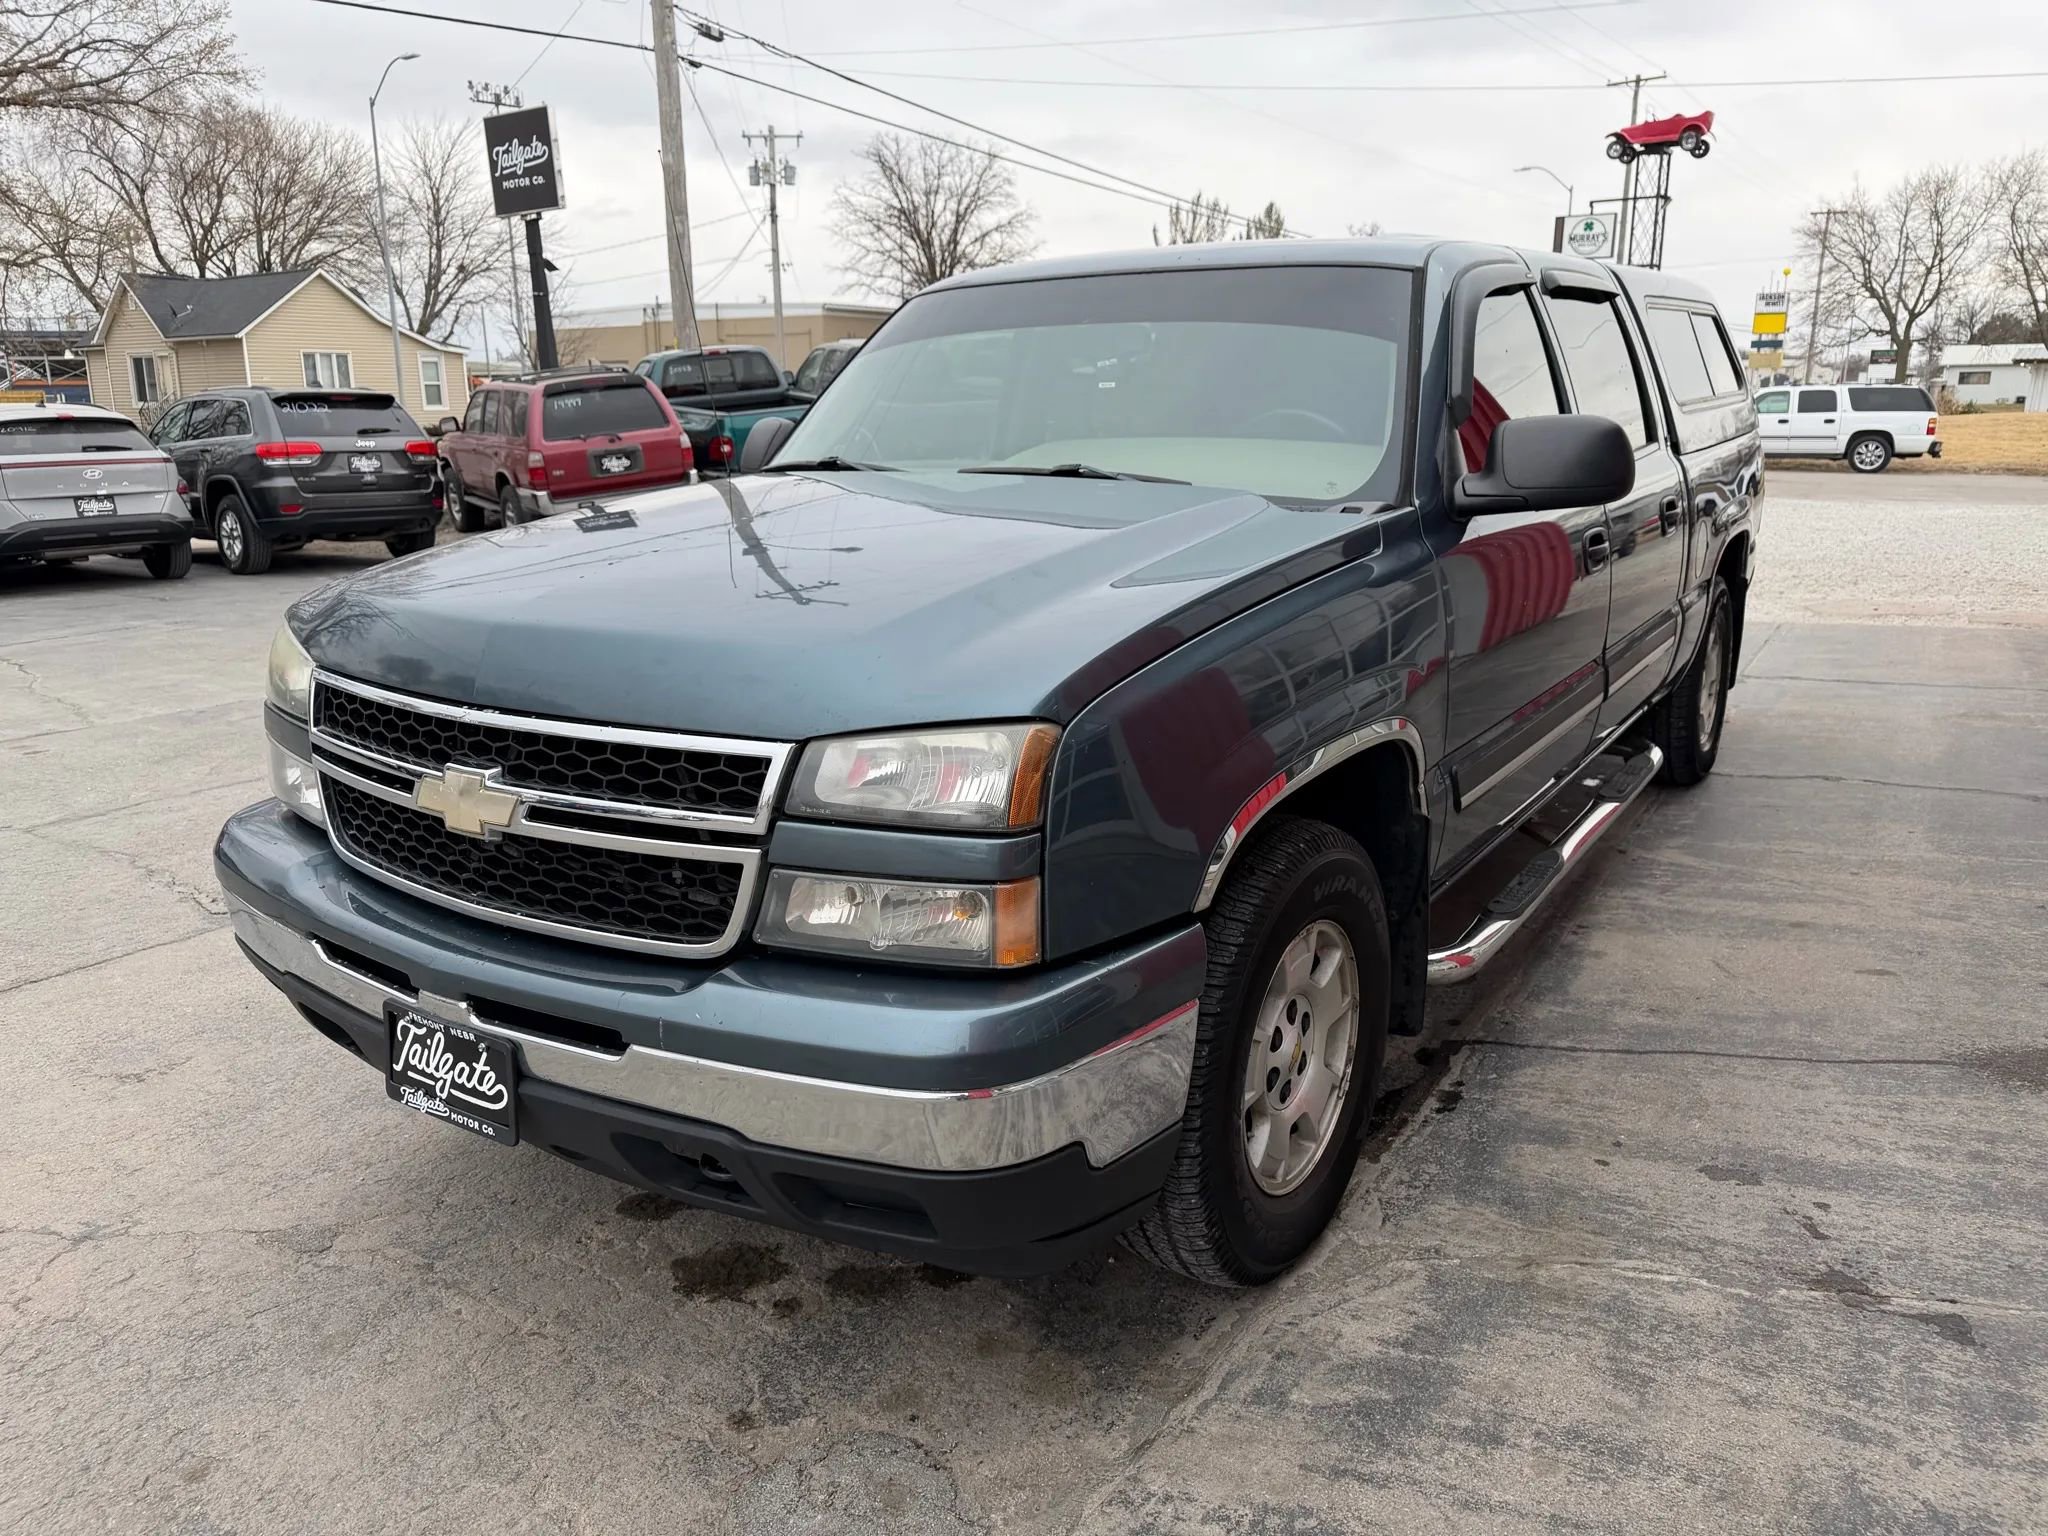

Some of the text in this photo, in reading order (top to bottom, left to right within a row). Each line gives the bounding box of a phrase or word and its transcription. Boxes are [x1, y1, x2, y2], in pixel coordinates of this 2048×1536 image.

[493, 134, 549, 177] Tailgate
[502, 175, 546, 190] MOTOR CO.
[281, 402, 332, 414] 21022
[355, 440, 376, 448] Jeep
[408, 1011, 445, 1032] FREMONT
[393, 1018, 508, 1110] Tailgate
[400, 1086, 496, 1137] Tailgate MOTOR CO.
